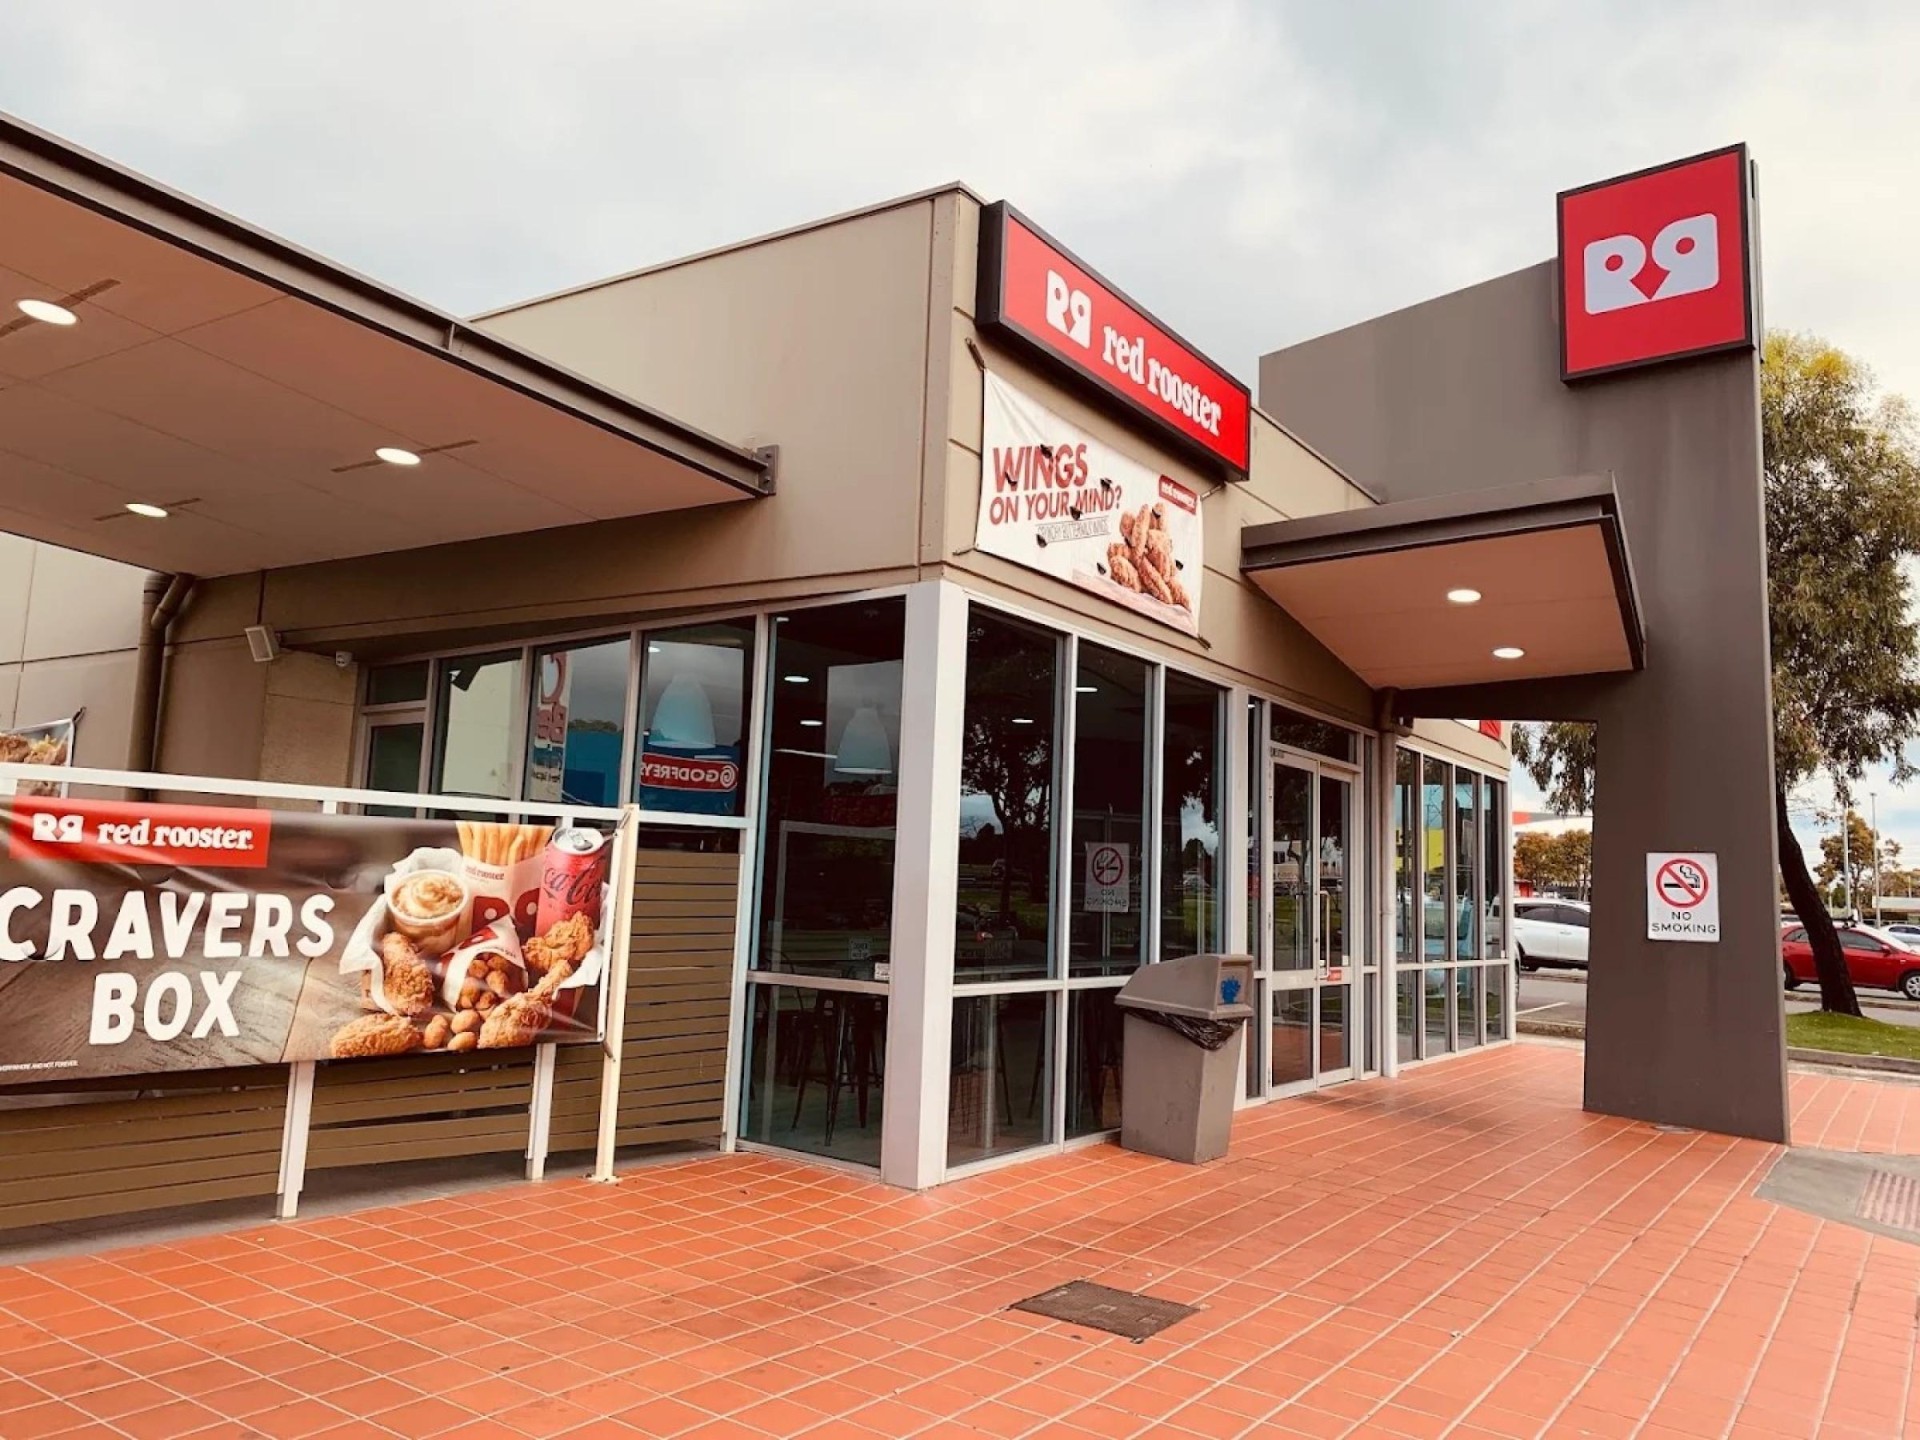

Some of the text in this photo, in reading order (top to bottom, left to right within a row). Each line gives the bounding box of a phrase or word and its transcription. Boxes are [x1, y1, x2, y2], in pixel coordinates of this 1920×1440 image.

[1102, 325, 1146, 385] red
[1147, 357, 1222, 437] rooster
[993, 444, 1088, 493] WINGS
[989, 485, 1122, 525] ON YOUR MIND?
[97, 819, 151, 846] red
[0, 886, 336, 962] CRAVERS
[1651, 922, 1717, 934] SMOKING
[1671, 911, 1692, 921] NO
[89, 971, 243, 1045] BOX
